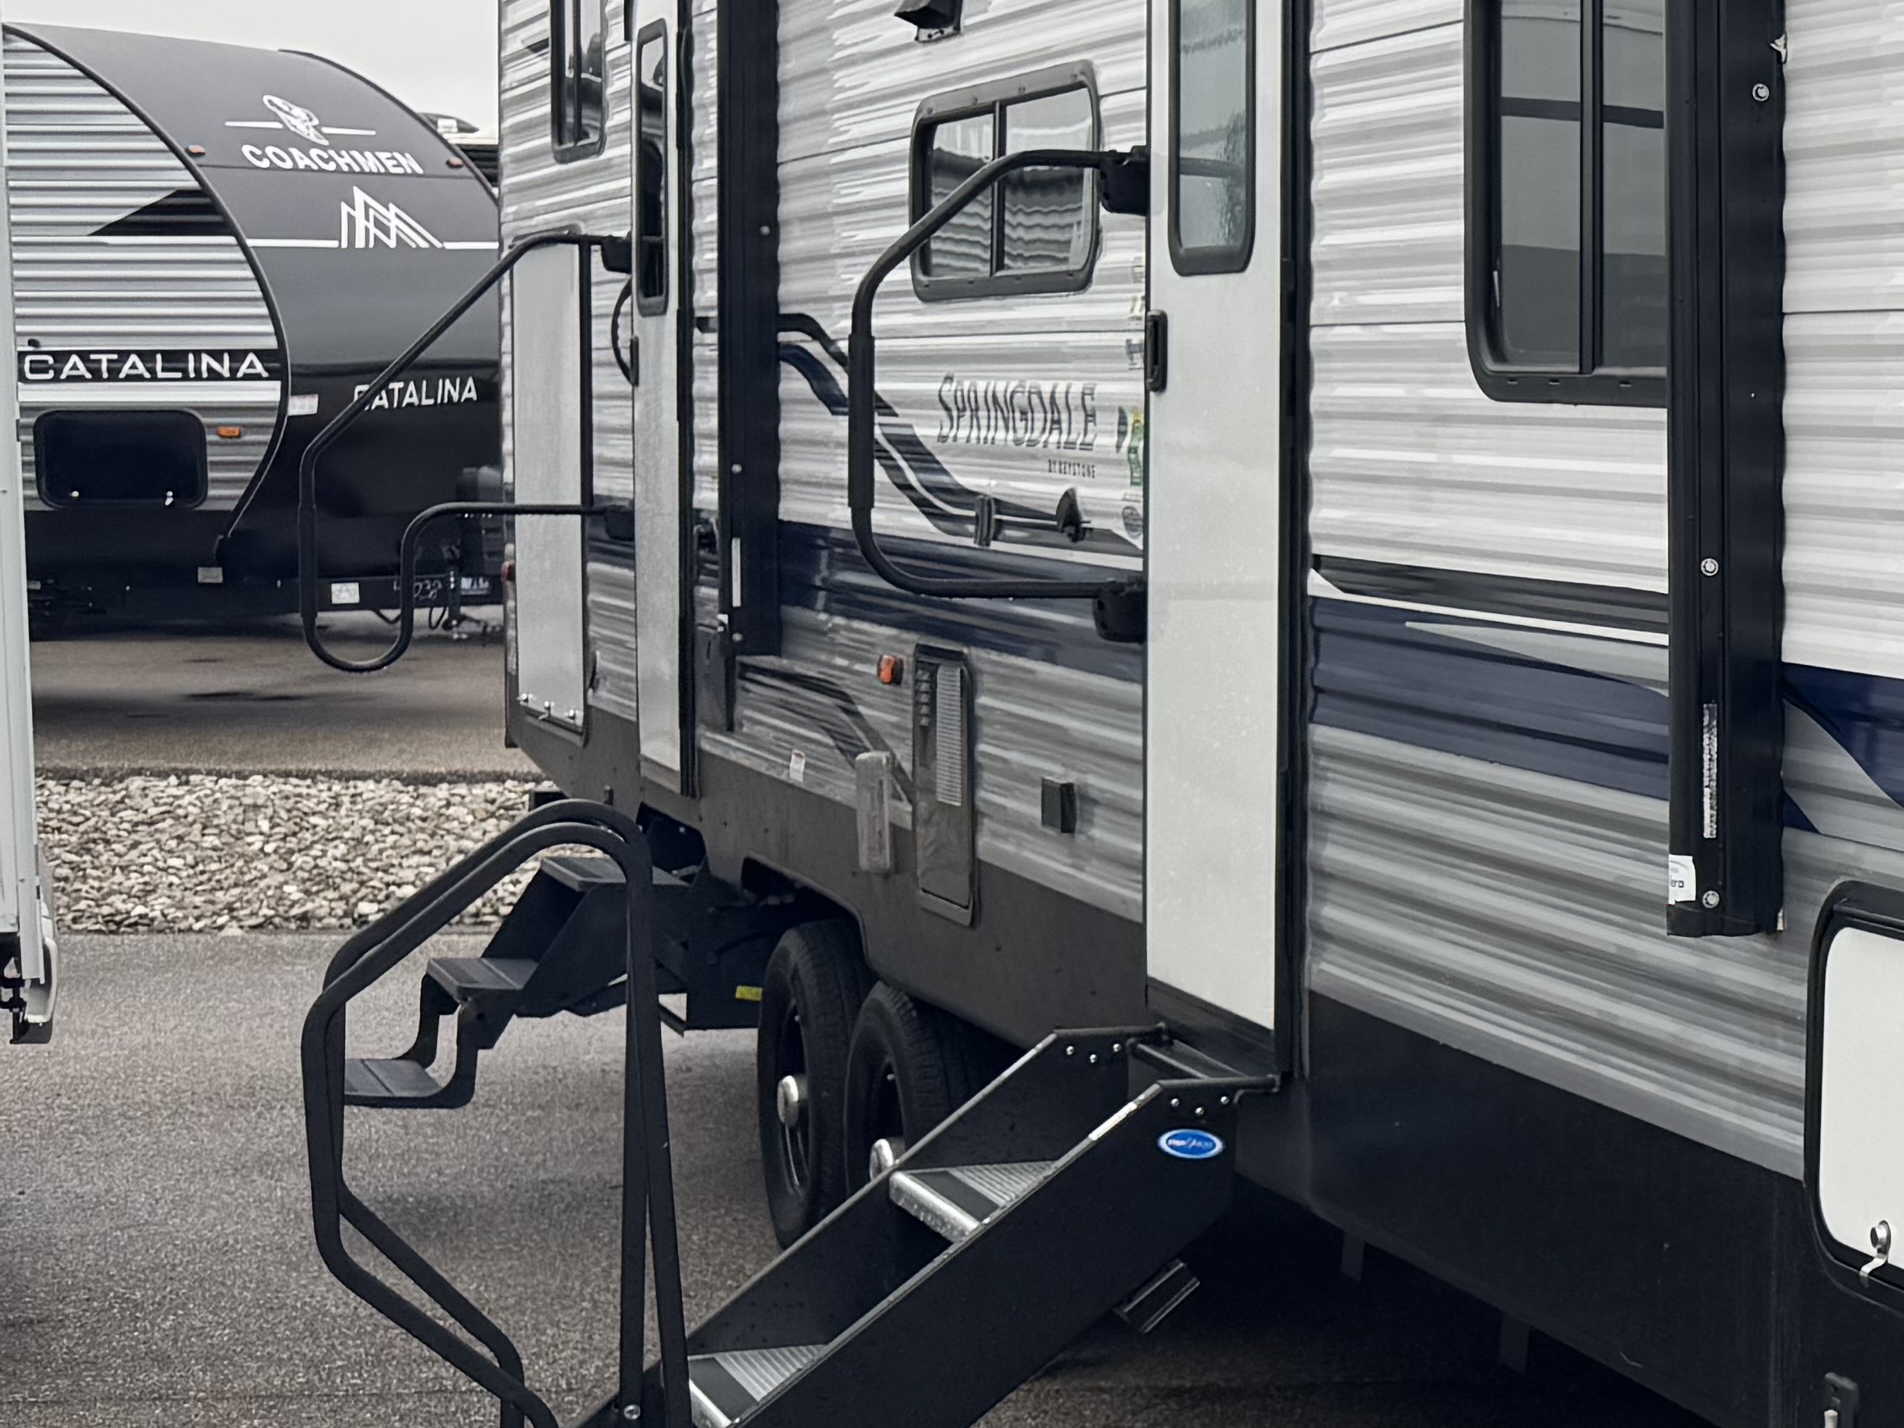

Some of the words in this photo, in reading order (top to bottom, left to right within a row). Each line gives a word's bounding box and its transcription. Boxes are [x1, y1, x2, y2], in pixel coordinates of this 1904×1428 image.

[241, 144, 424, 175] COACHMEN
[23, 352, 270, 381] CATALINA
[936, 371, 1098, 452] SPRINGDALE
